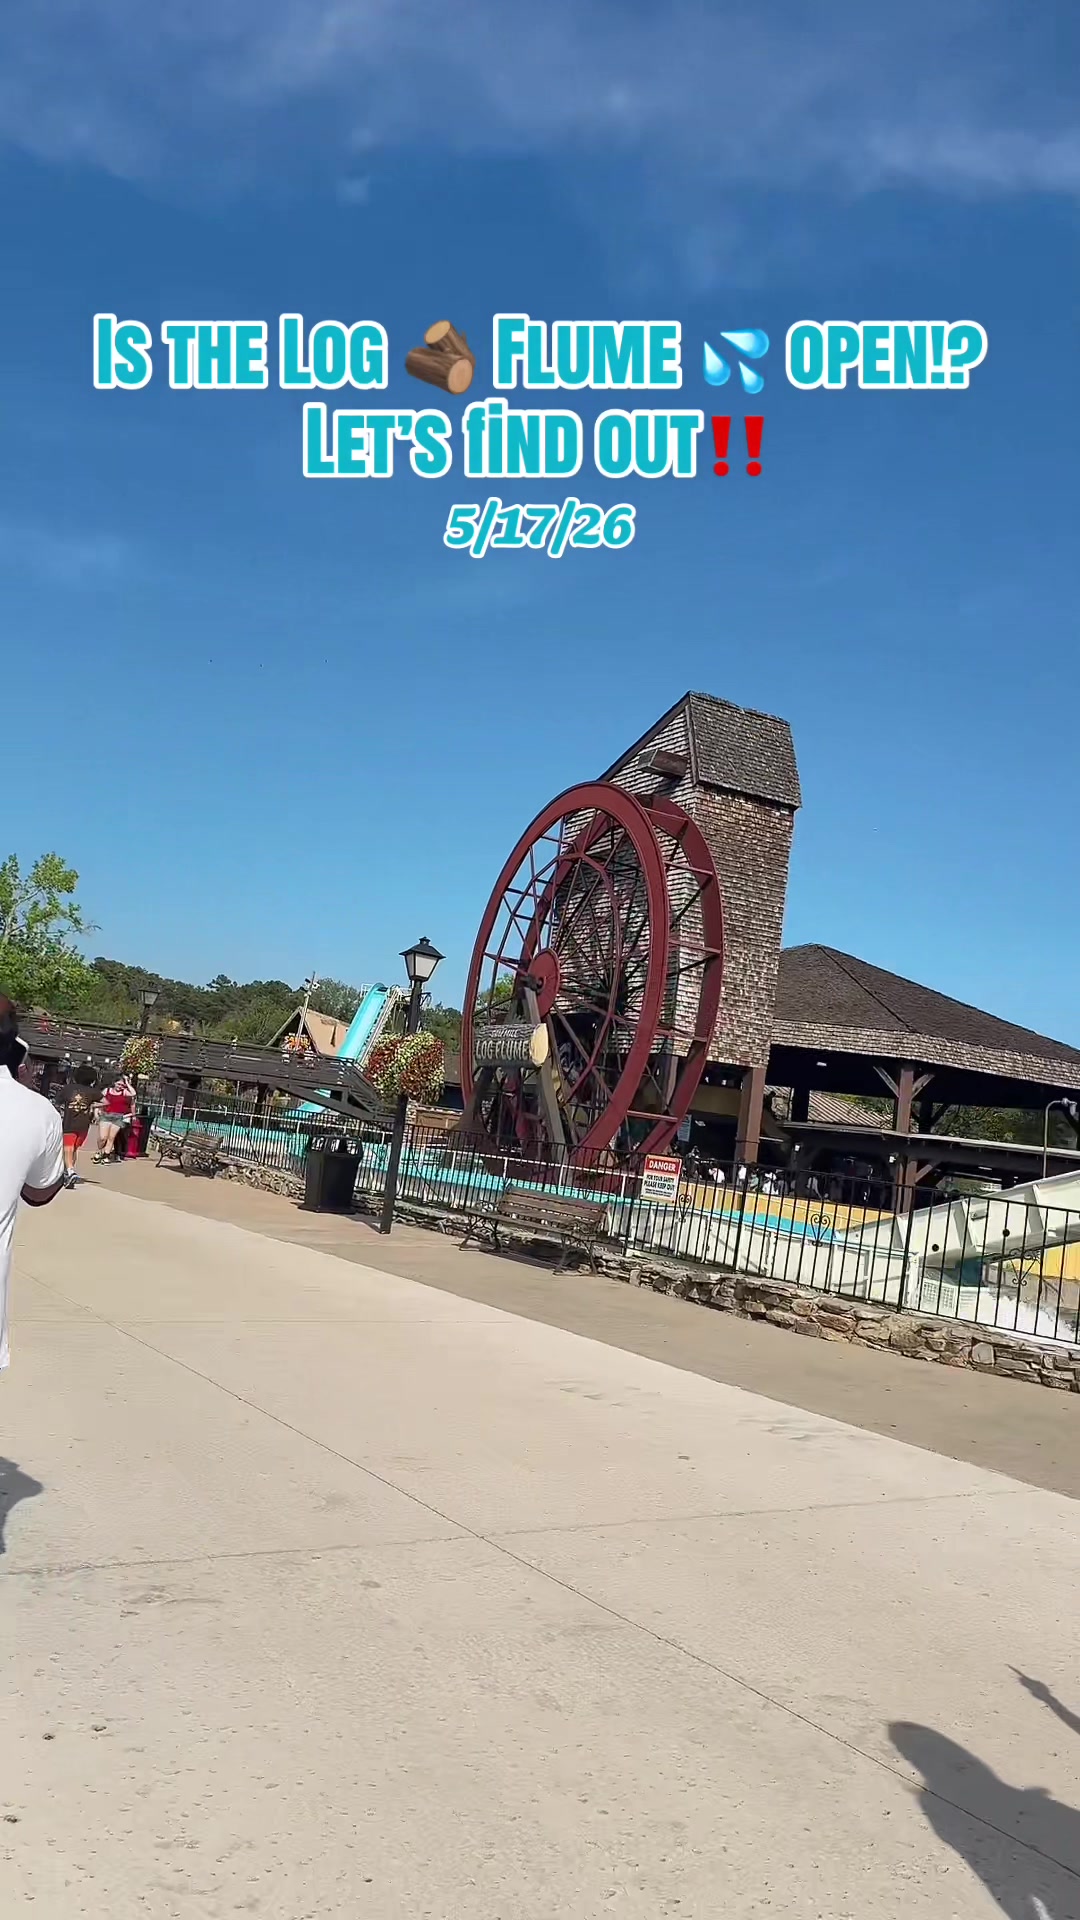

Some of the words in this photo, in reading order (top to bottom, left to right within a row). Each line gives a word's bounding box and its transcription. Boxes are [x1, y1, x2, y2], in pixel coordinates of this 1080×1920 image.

[476, 1040, 493, 1060] LOG
[495, 1040, 529, 1060] FLUME
[649, 1160, 676, 1171] DANGER
